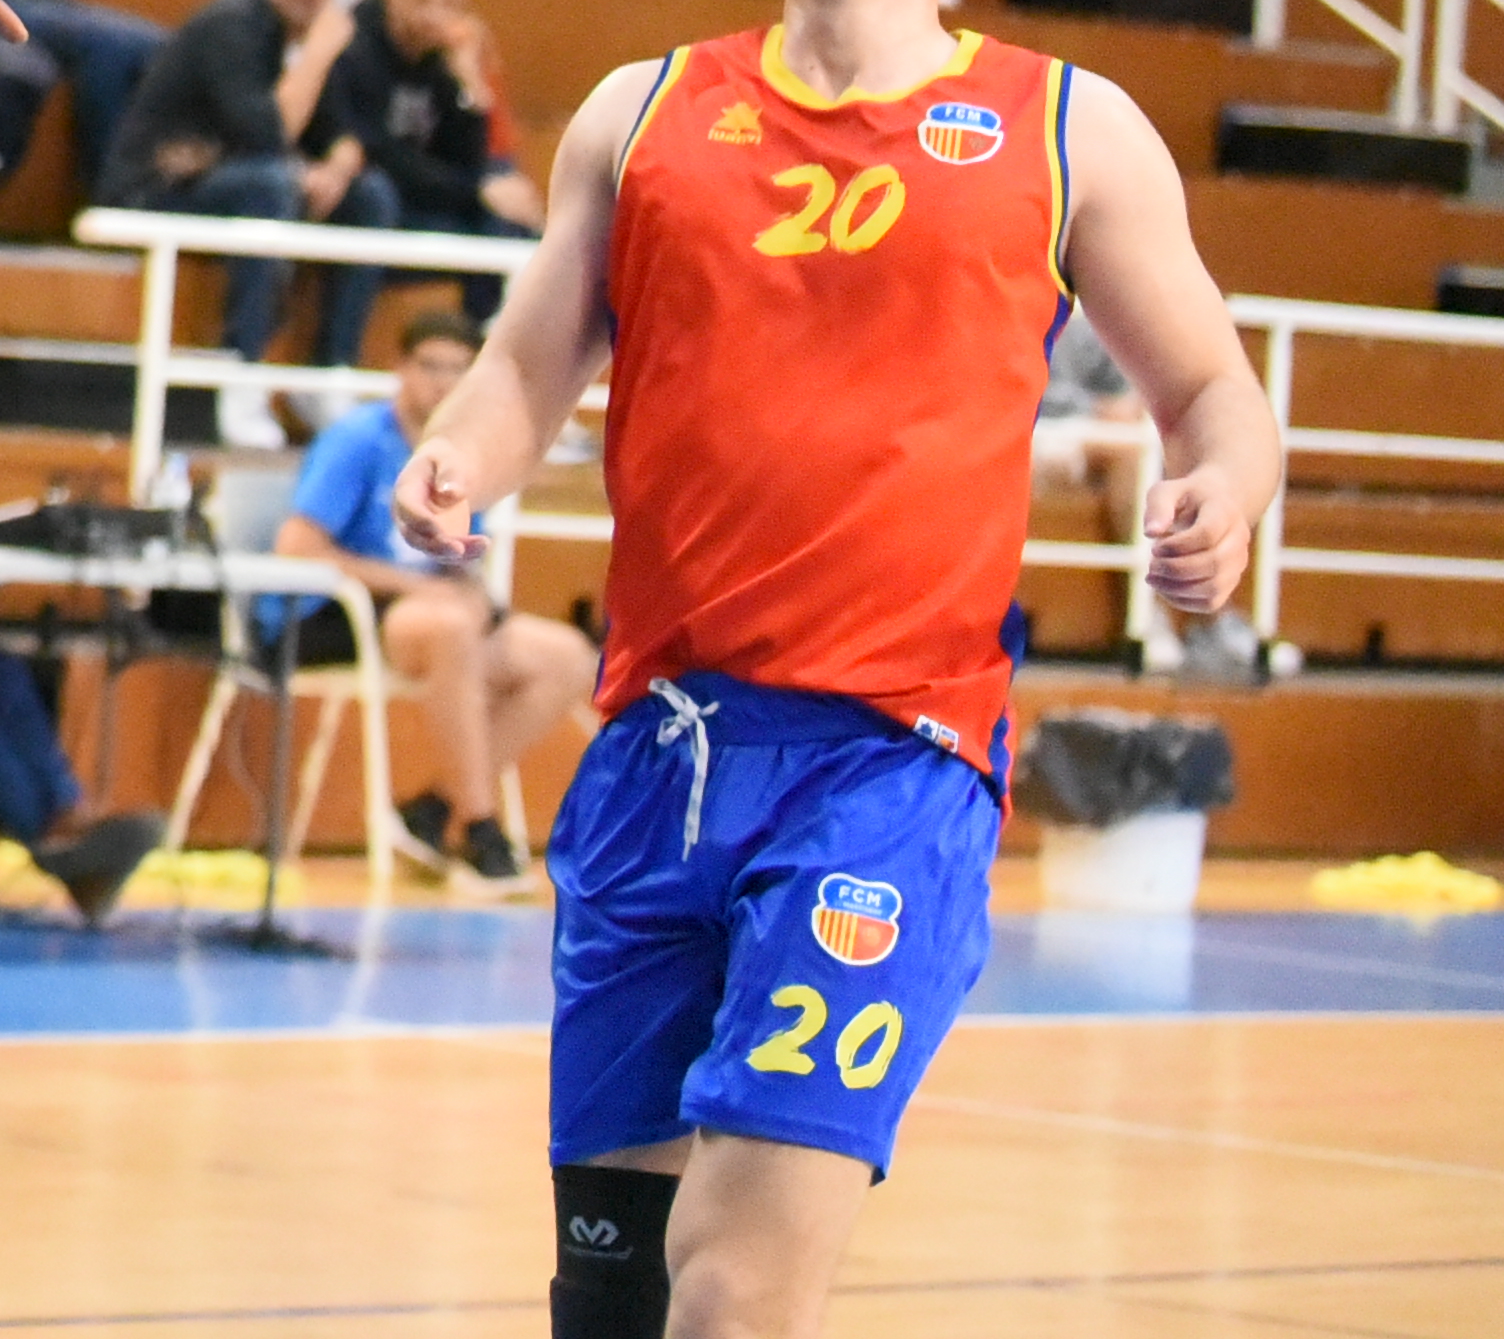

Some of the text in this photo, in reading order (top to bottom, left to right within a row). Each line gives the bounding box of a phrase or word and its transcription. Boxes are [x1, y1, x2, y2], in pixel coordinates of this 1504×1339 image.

[751, 163, 907, 257] 20
[838, 884, 882, 908] FCM
[745, 984, 903, 1089] 20
